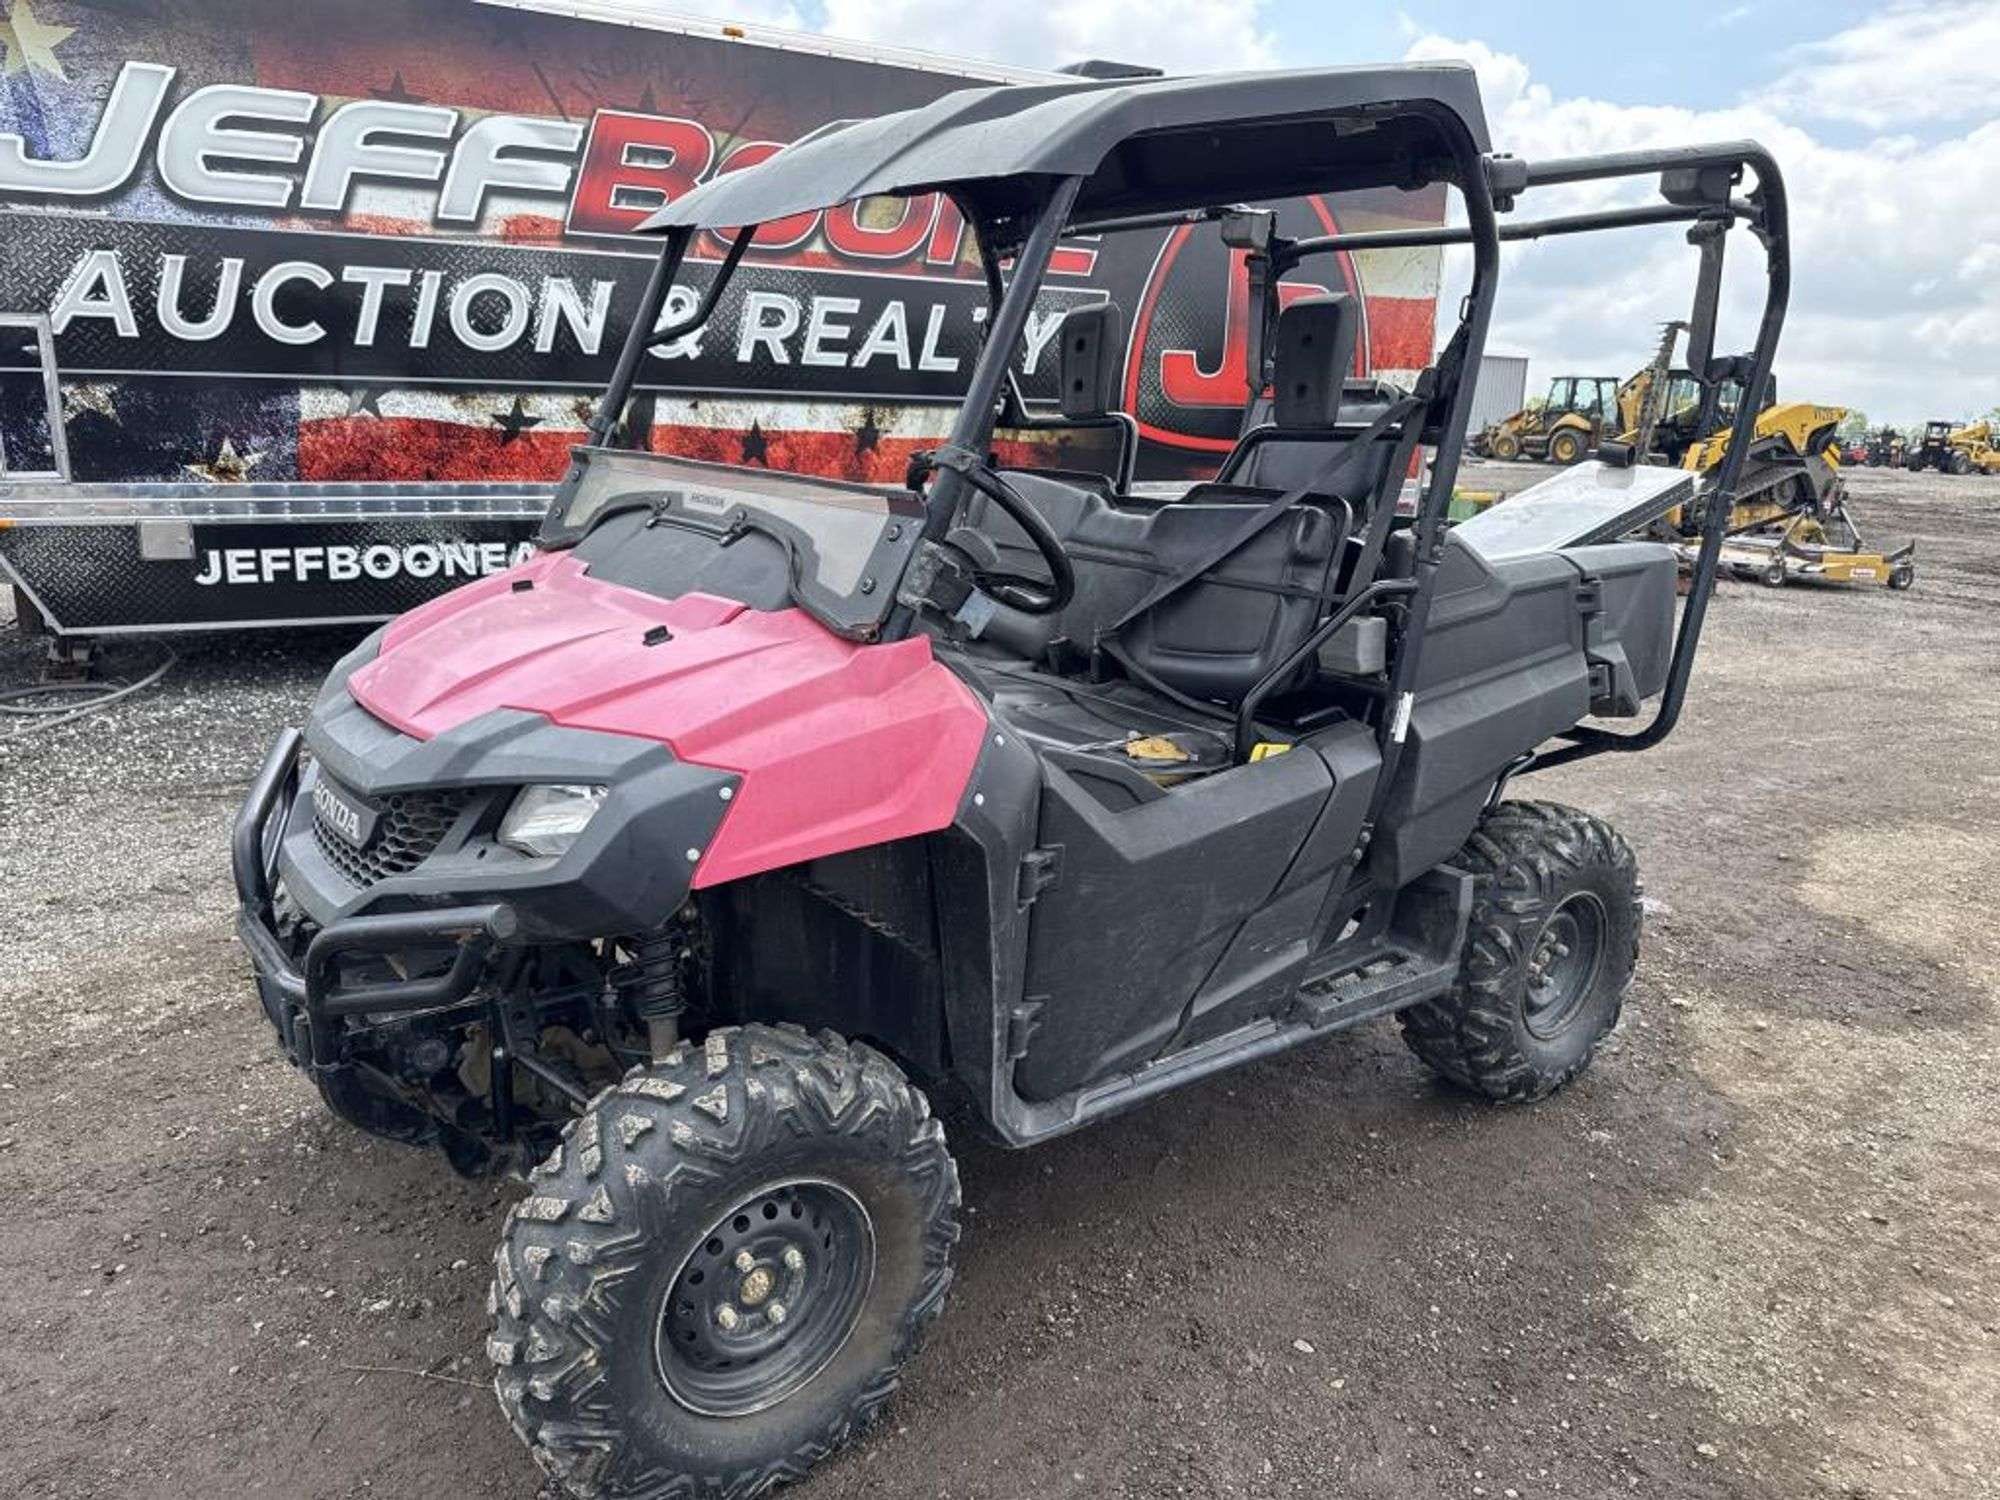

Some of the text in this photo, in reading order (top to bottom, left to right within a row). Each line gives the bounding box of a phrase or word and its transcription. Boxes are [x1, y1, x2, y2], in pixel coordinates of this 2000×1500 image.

[51, 249, 1067, 376] AUCTION & REALY
[313, 780, 360, 840] HONDA
